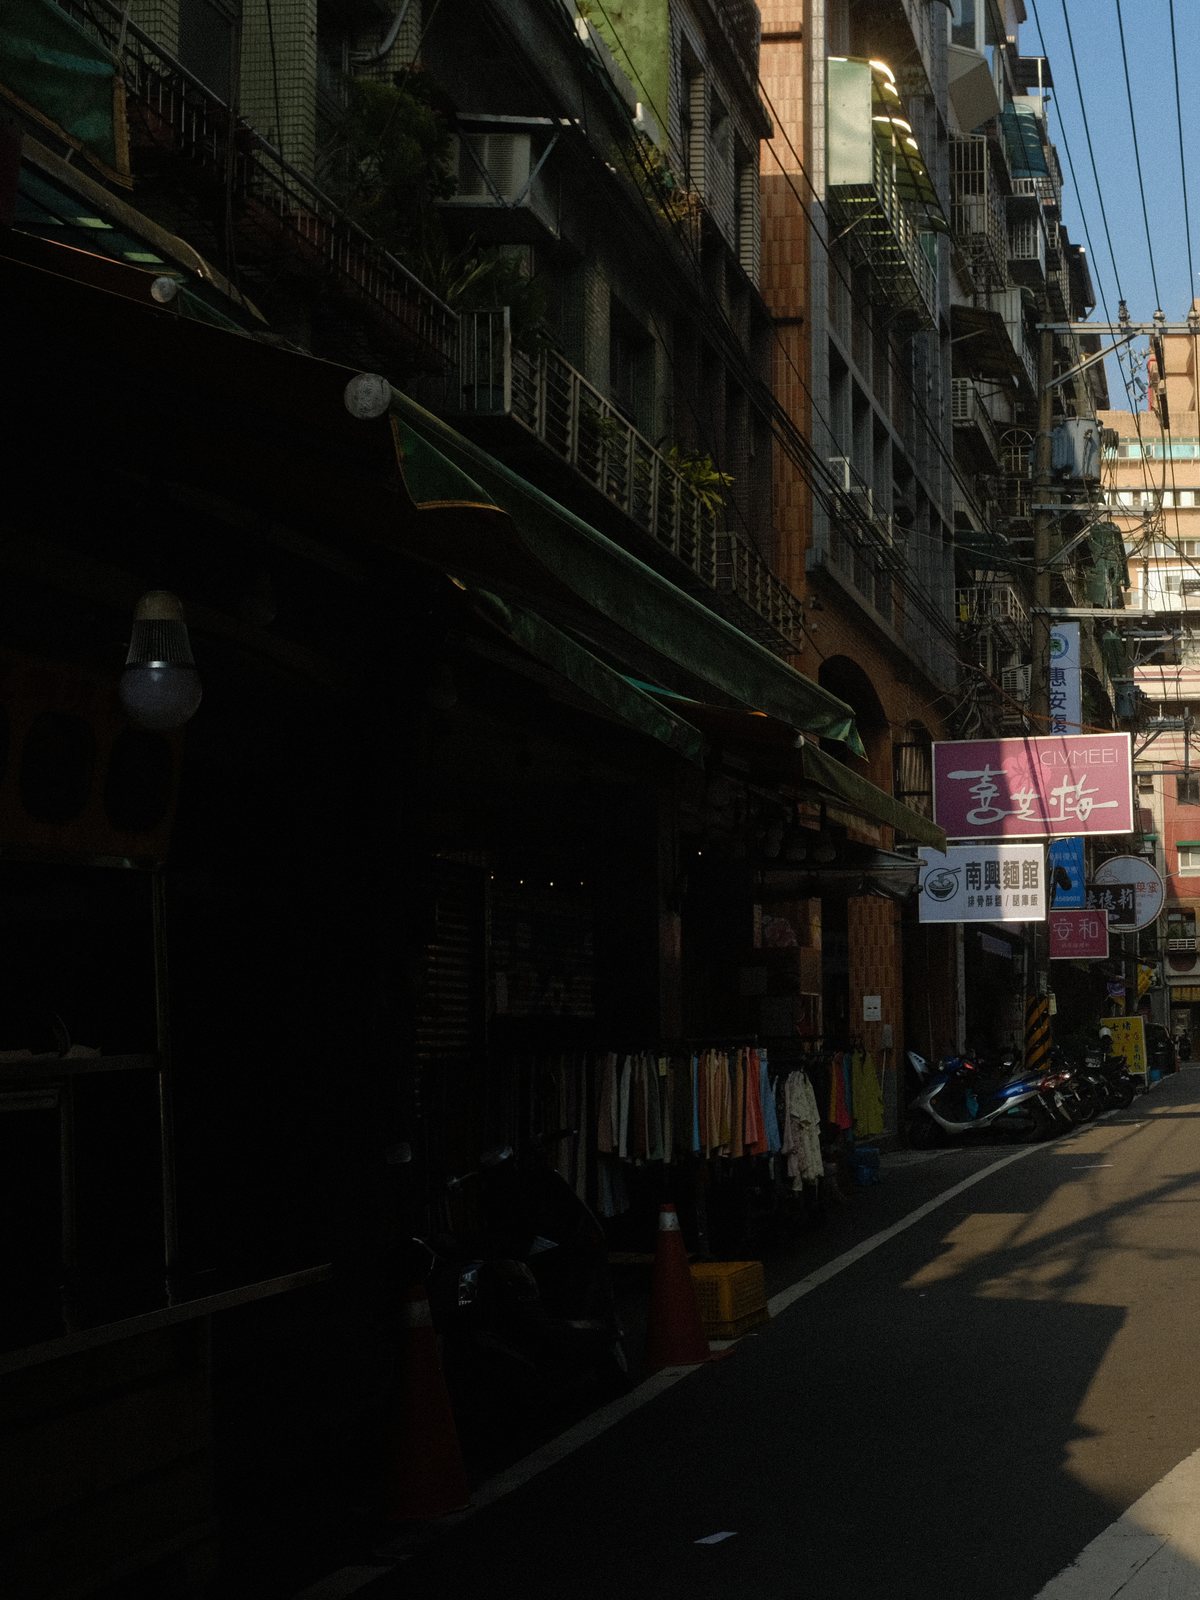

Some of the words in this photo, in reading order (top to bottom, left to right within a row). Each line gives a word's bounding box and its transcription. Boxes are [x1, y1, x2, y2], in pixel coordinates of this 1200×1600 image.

[1040, 748, 1119, 766] CIVMEEI
[966, 860, 1039, 891] 南興麵館
